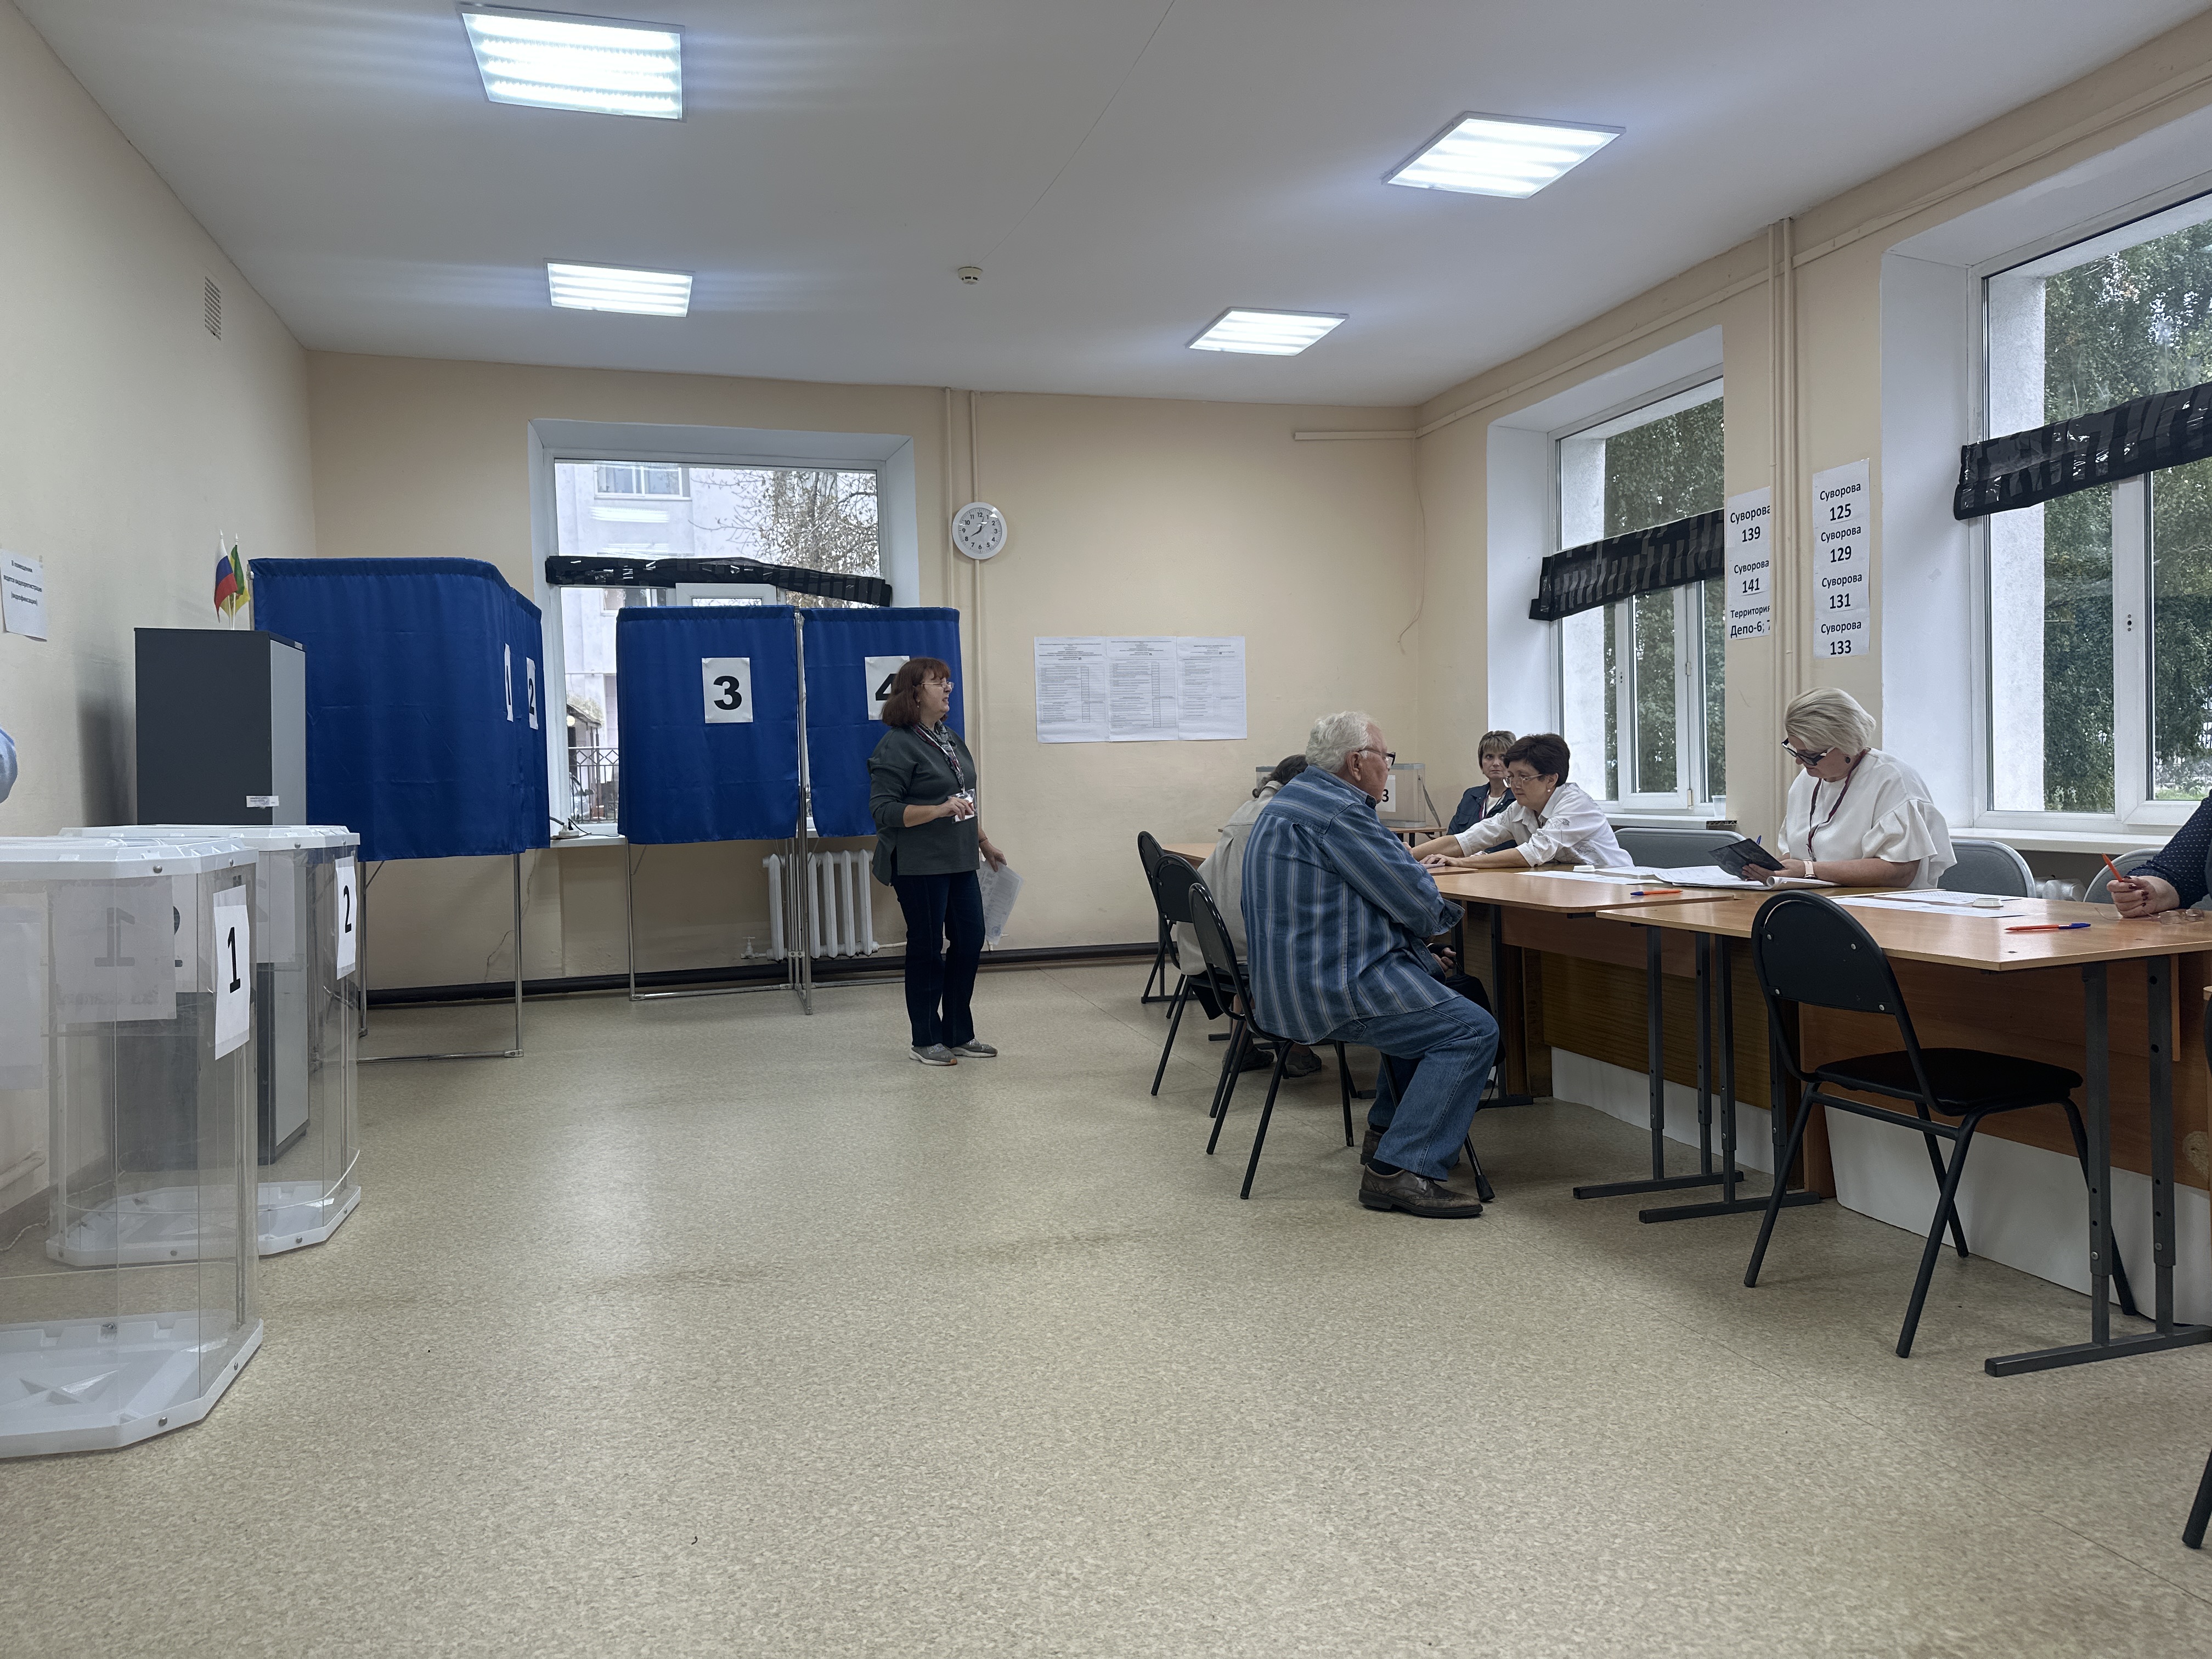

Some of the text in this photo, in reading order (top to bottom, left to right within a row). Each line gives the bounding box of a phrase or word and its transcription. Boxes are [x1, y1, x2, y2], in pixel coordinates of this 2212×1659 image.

[1820, 483, 1861, 501] Суворова
[1730, 505, 1770, 524] Суворова
[1830, 503, 1851, 521] 125
[1742, 526, 1760, 543] 139
[1821, 526, 1861, 543] Суворова
[1830, 545, 1852, 563] 129
[1734, 560, 1769, 575] Суворова
[1742, 578, 1760, 594] 141
[1822, 574, 1862, 589] Суворова
[1830, 593, 1851, 610] 131
[1730, 621, 1765, 639] Депо-6;
[1821, 621, 1861, 635] Суворова
[1830, 640, 1852, 655] 133
[506, 665, 511, 706] 1
[713, 675, 742, 710] 3
[528, 678, 535, 716] 2
[1382, 789, 1389, 802] 3
[343, 885, 352, 933] 2
[228, 926, 241, 994] 1
